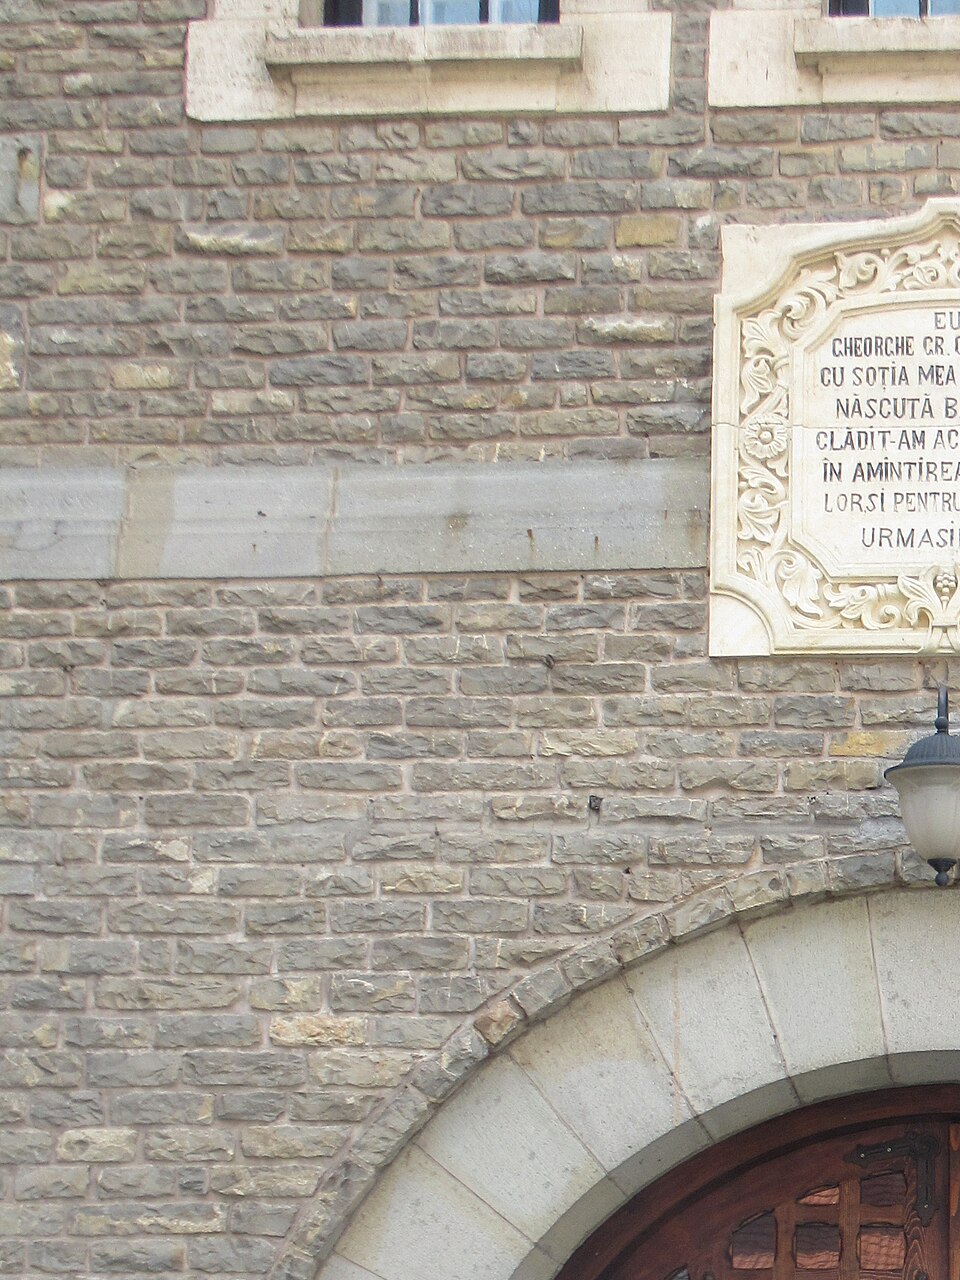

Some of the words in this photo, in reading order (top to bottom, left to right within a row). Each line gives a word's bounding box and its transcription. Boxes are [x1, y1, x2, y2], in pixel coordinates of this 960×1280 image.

[832, 336, 915, 357] GHEORGHE
[923, 336, 950, 356] GR.
[820, 366, 845, 386] CU
[918, 365, 957, 386] MEA
